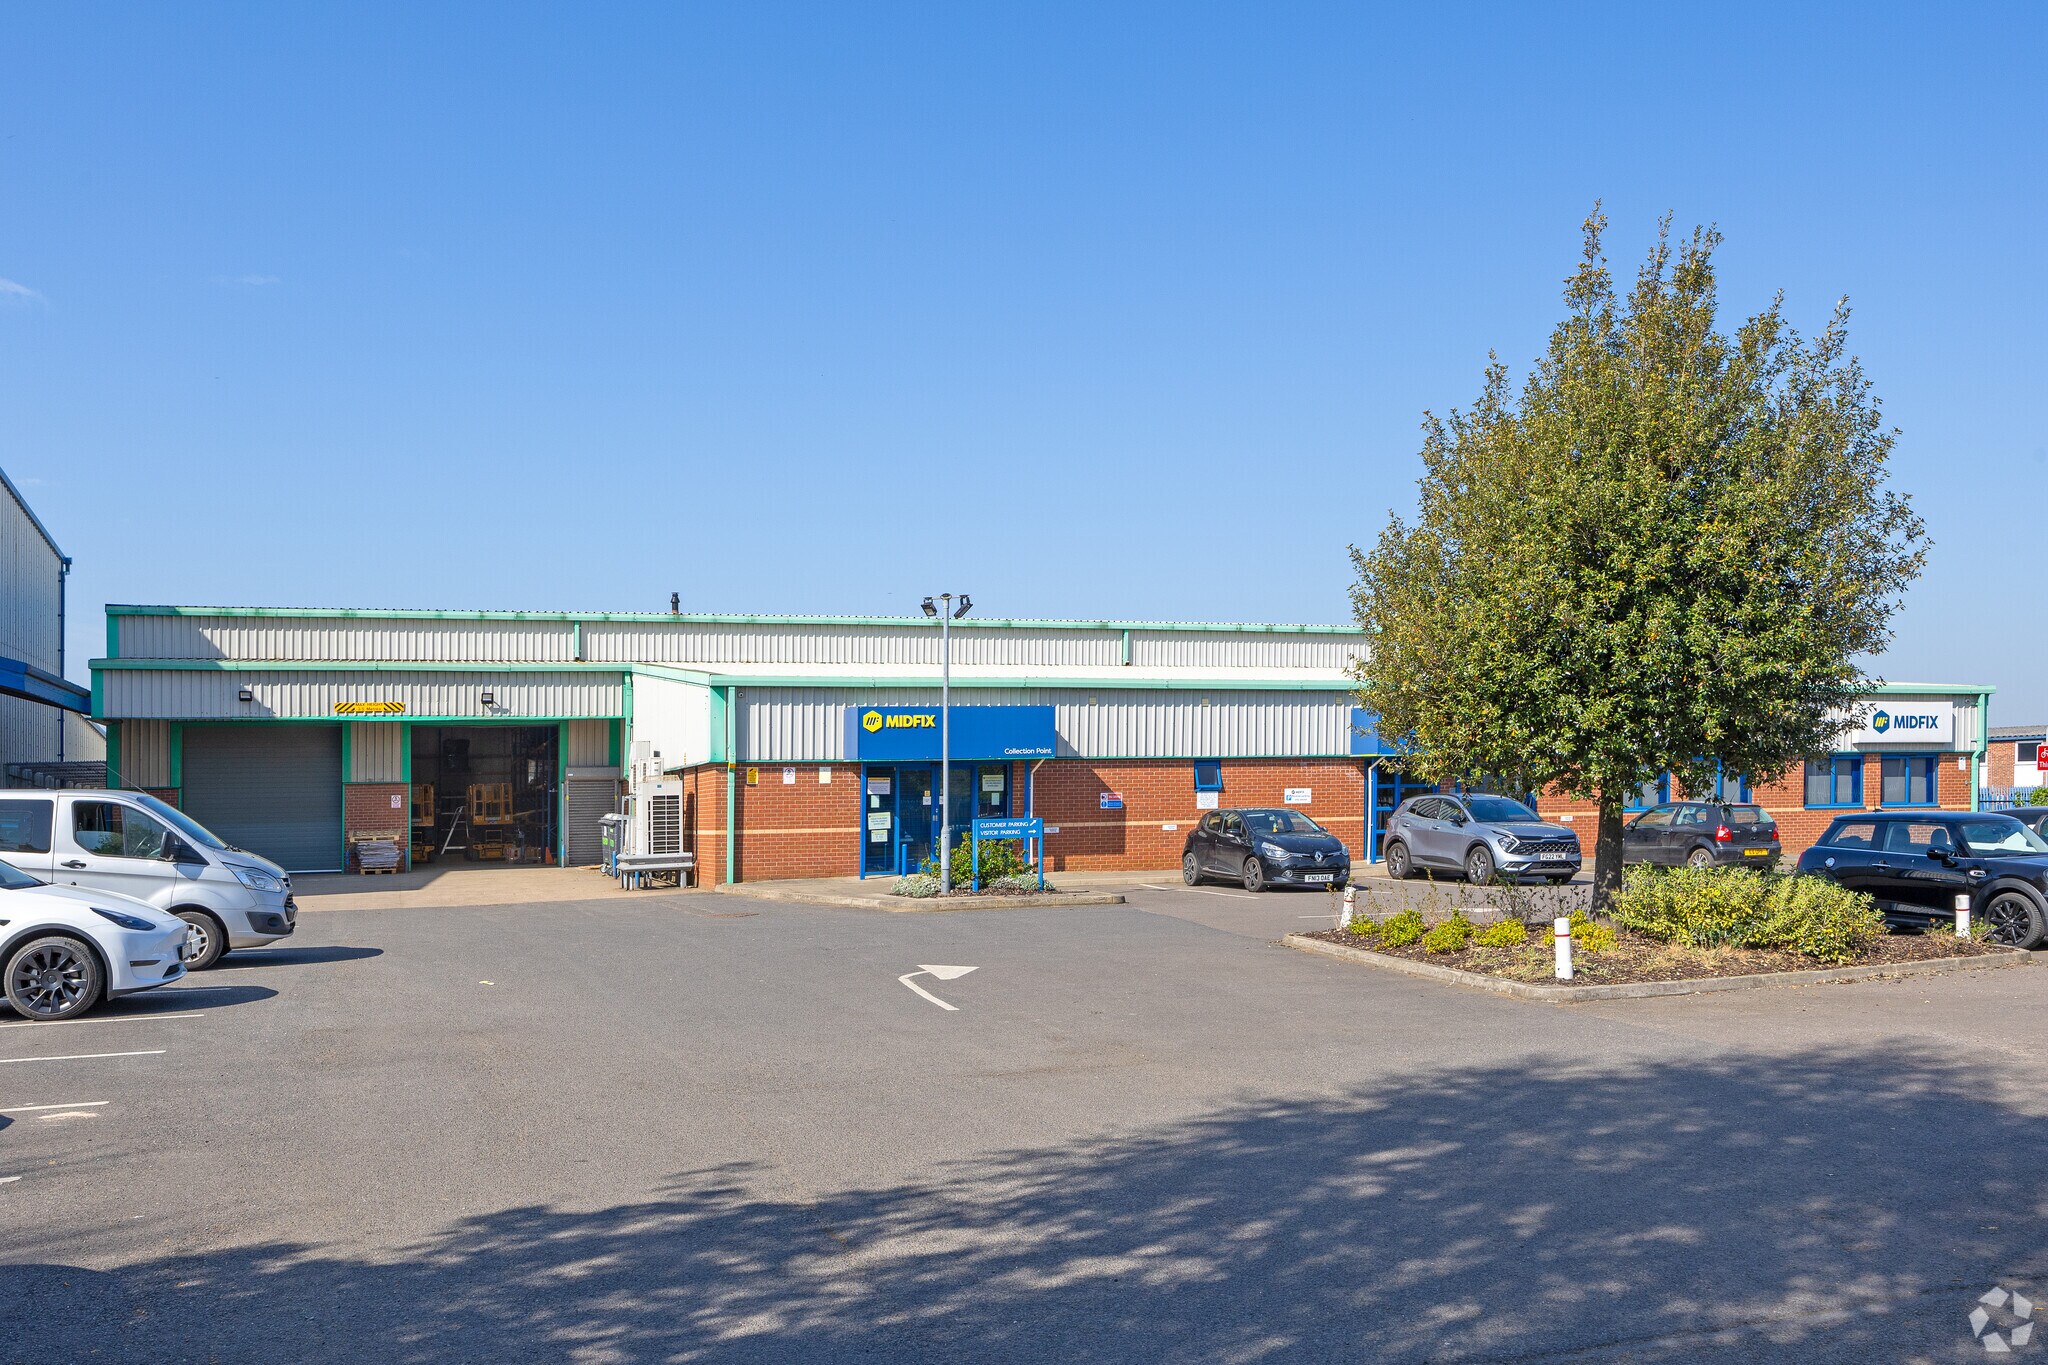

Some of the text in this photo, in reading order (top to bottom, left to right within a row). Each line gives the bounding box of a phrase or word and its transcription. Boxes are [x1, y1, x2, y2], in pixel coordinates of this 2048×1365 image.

[886, 715, 936, 728] MIDFIX
[1893, 715, 1939, 729] MIDFIX
[1004, 747, 1035, 755] Collection
